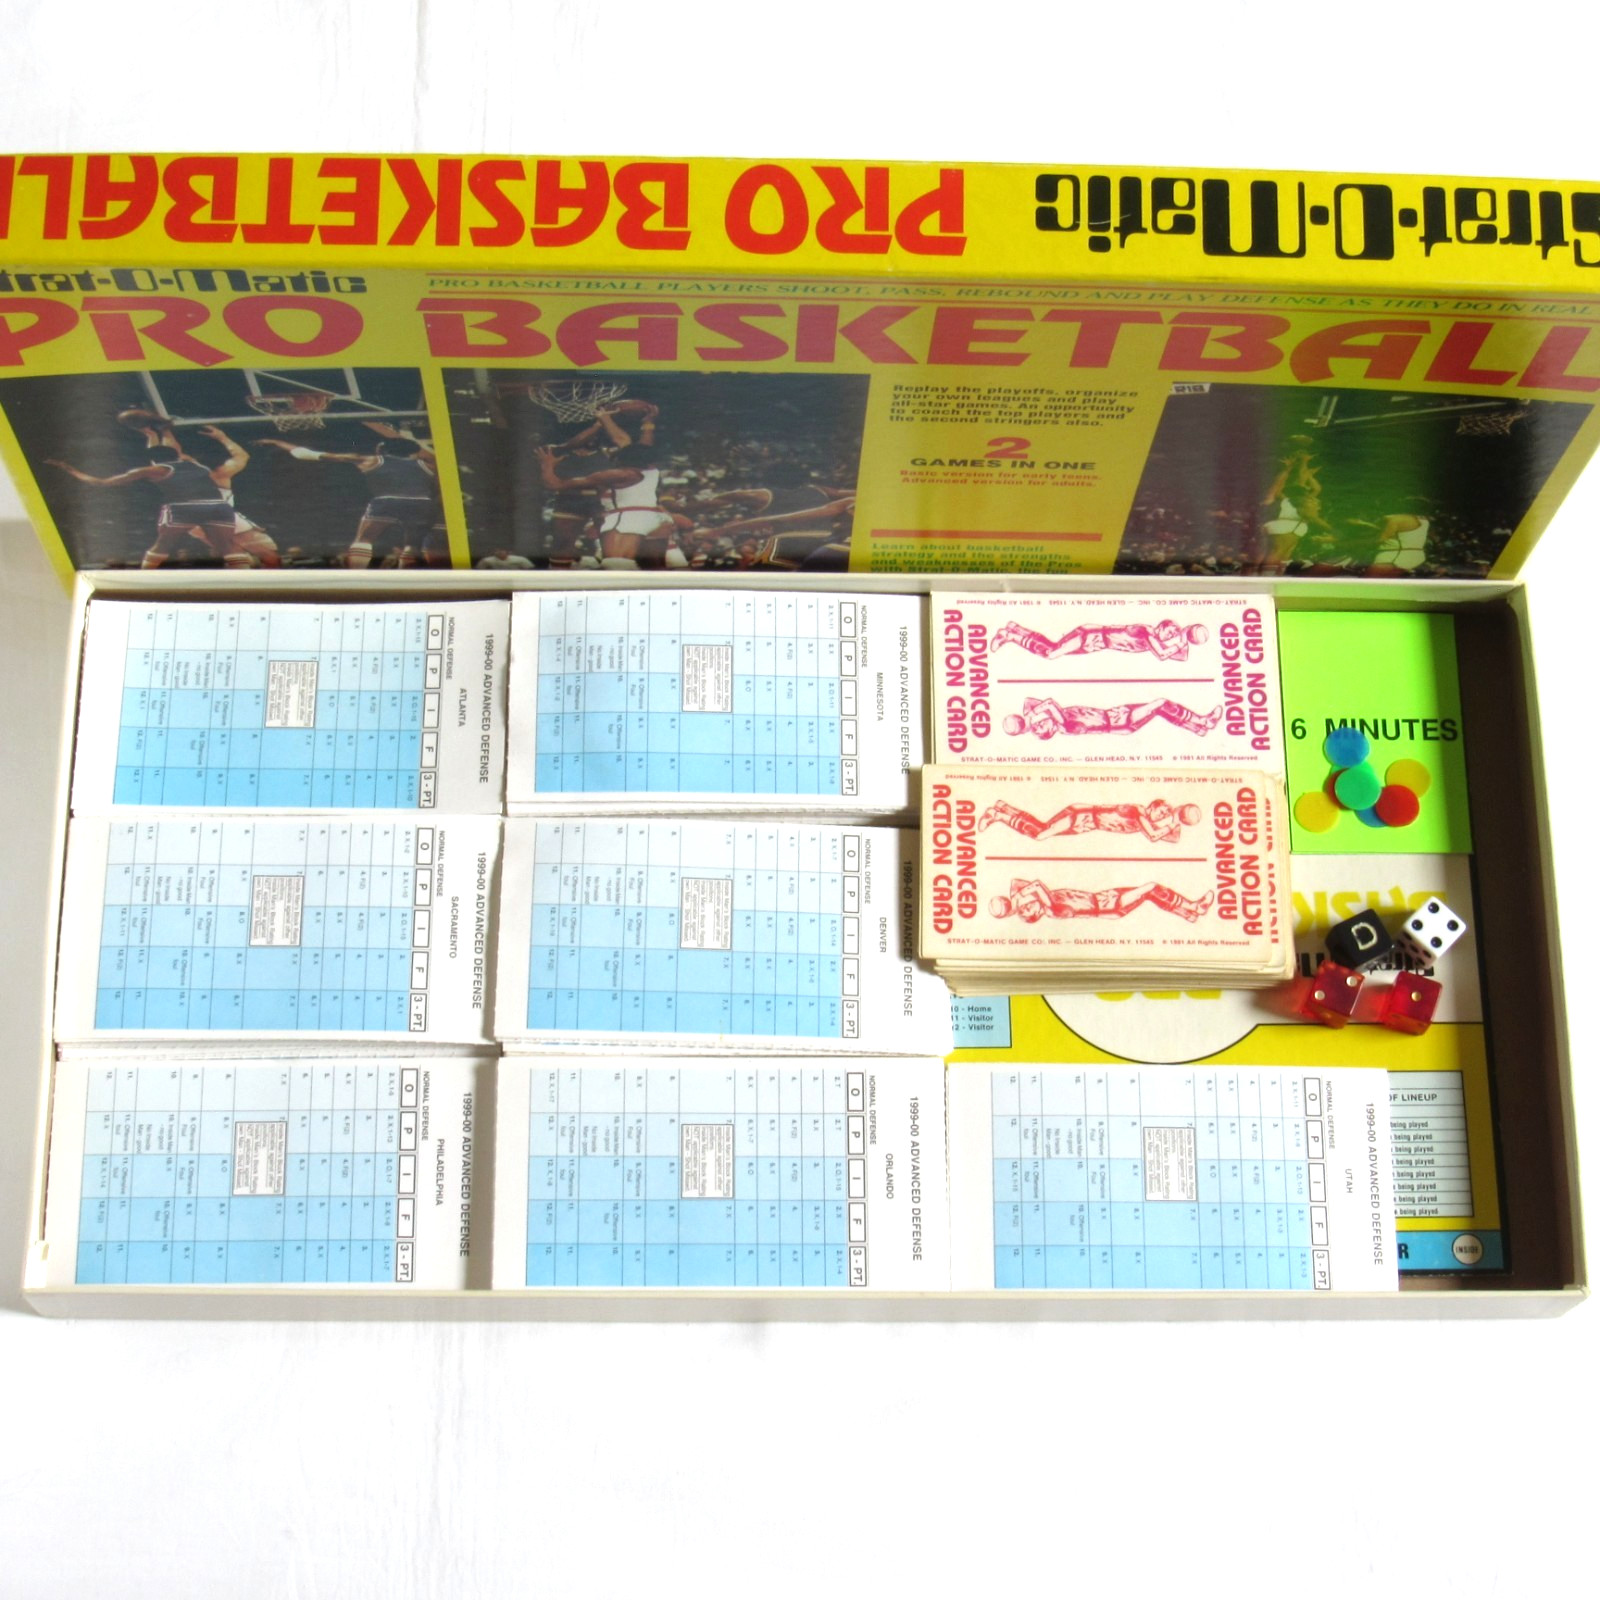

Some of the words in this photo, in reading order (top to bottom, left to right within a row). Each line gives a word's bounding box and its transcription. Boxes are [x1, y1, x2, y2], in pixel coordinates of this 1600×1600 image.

[725, 157, 968, 257] PRO
[429, 279, 480, 288] PRO
[488, 279, 647, 291] BASKETBALL
[657, 282, 768, 293] PLAYERS
[777, 284, 870, 296] SHOOT,
[880, 286, 947, 297] PASS,
[956, 288, 1080, 299] REBOUND
[1085, 290, 1142, 301] AND
[1146, 293, 1210, 302] PLAY
[1220, 294, 1336, 306] DEFENSE
[1338, 296, 1370, 307] AS
[1382, 299, 1453, 310] THEY
[1452, 301, 1492, 311] DO
[1497, 302, 1527, 312] IN
[1534, 303, 1592, 314] REAL
[0, 296, 364, 367] PRO
[416, 298, 1600, 392] BASKETBALL
[892, 393, 929, 401] your
[977, 394, 1040, 403] leagues
[1081, 396, 1117, 405] play
[893, 385, 949, 393] Replay
[1065, 389, 1138, 397] organize
[912, 408, 960, 416] coach
[998, 409, 1023, 418] top
[1028, 410, 1090, 419] players
[1096, 412, 1125, 420] and
[1044, 404, 1135, 413] opportunity
[921, 415, 979, 423] second
[984, 416, 1060, 426] stringers
[1066, 419, 1103, 427] also.
[910, 458, 1006, 468] GAMES
[1011, 459, 1036, 469] IN
[1043, 460, 1096, 470] ONE
[984, 436, 1031, 459] 2
[920, 543, 961, 551] about
[966, 544, 1044, 552] basketball
[484, 634, 493, 670] 1999-00
[944, 609, 965, 687] ACTION
[1242, 607, 1264, 664] CARD
[481, 674, 491, 731] ADVANCED
[876, 672, 884, 721] MINNESOTA
[900, 666, 908, 722] ADVANCED
[968, 624, 990, 739] ADVANCED
[1220, 622, 1246, 736] ADVANCED
[458, 688, 467, 727] ATLANTA
[947, 696, 967, 753] CARD
[1247, 673, 1270, 750] ACTION
[1291, 717, 1306, 740] 6
[479, 735, 489, 783] DEFENSE
[901, 727, 909, 774] DEFENSE
[1207, 755, 1227, 763] Rights
[933, 784, 952, 865] ACTION
[1237, 787, 1257, 846] CARD
[477, 852, 486, 890] 1999-00
[904, 861, 912, 899] 1999-00
[956, 800, 976, 919] ADVANCED
[1214, 801, 1238, 920] ADVANCED
[933, 875, 953, 934] CARD
[1239, 855, 1263, 936] ACTION
[449, 896, 459, 958] SACRAMENTO
[474, 894, 485, 954] ADVANCED
[904, 903, 912, 962] ADVANCED
[1351, 922, 1378, 950] D
[472, 958, 483, 1008] DEFENSE
[904, 966, 912, 1016] DEFENSE
[463, 1092, 472, 1132] 1999-00
[851, 1088, 860, 1096] O
[910, 1097, 919, 1136] 1999-00
[1327, 1116, 1335, 1149] DEFENSE
[1366, 1103, 1376, 1142] 1999-00
[435, 1139, 445, 1205] PHILADELPHIA
[461, 1137, 471, 1199] ADVANCED
[885, 1153, 894, 1199] ORLANDO
[911, 1141, 920, 1203] ADVANCED
[1345, 1169, 1353, 1193] UTAH
[1368, 1146, 1379, 1208] ADVANCED
[460, 1204, 470, 1257] DEFENSE
[912, 1208, 922, 1261] DEFENSE
[1371, 1213, 1383, 1265] DEFENSE
[853, 1268, 862, 1285] PT.
